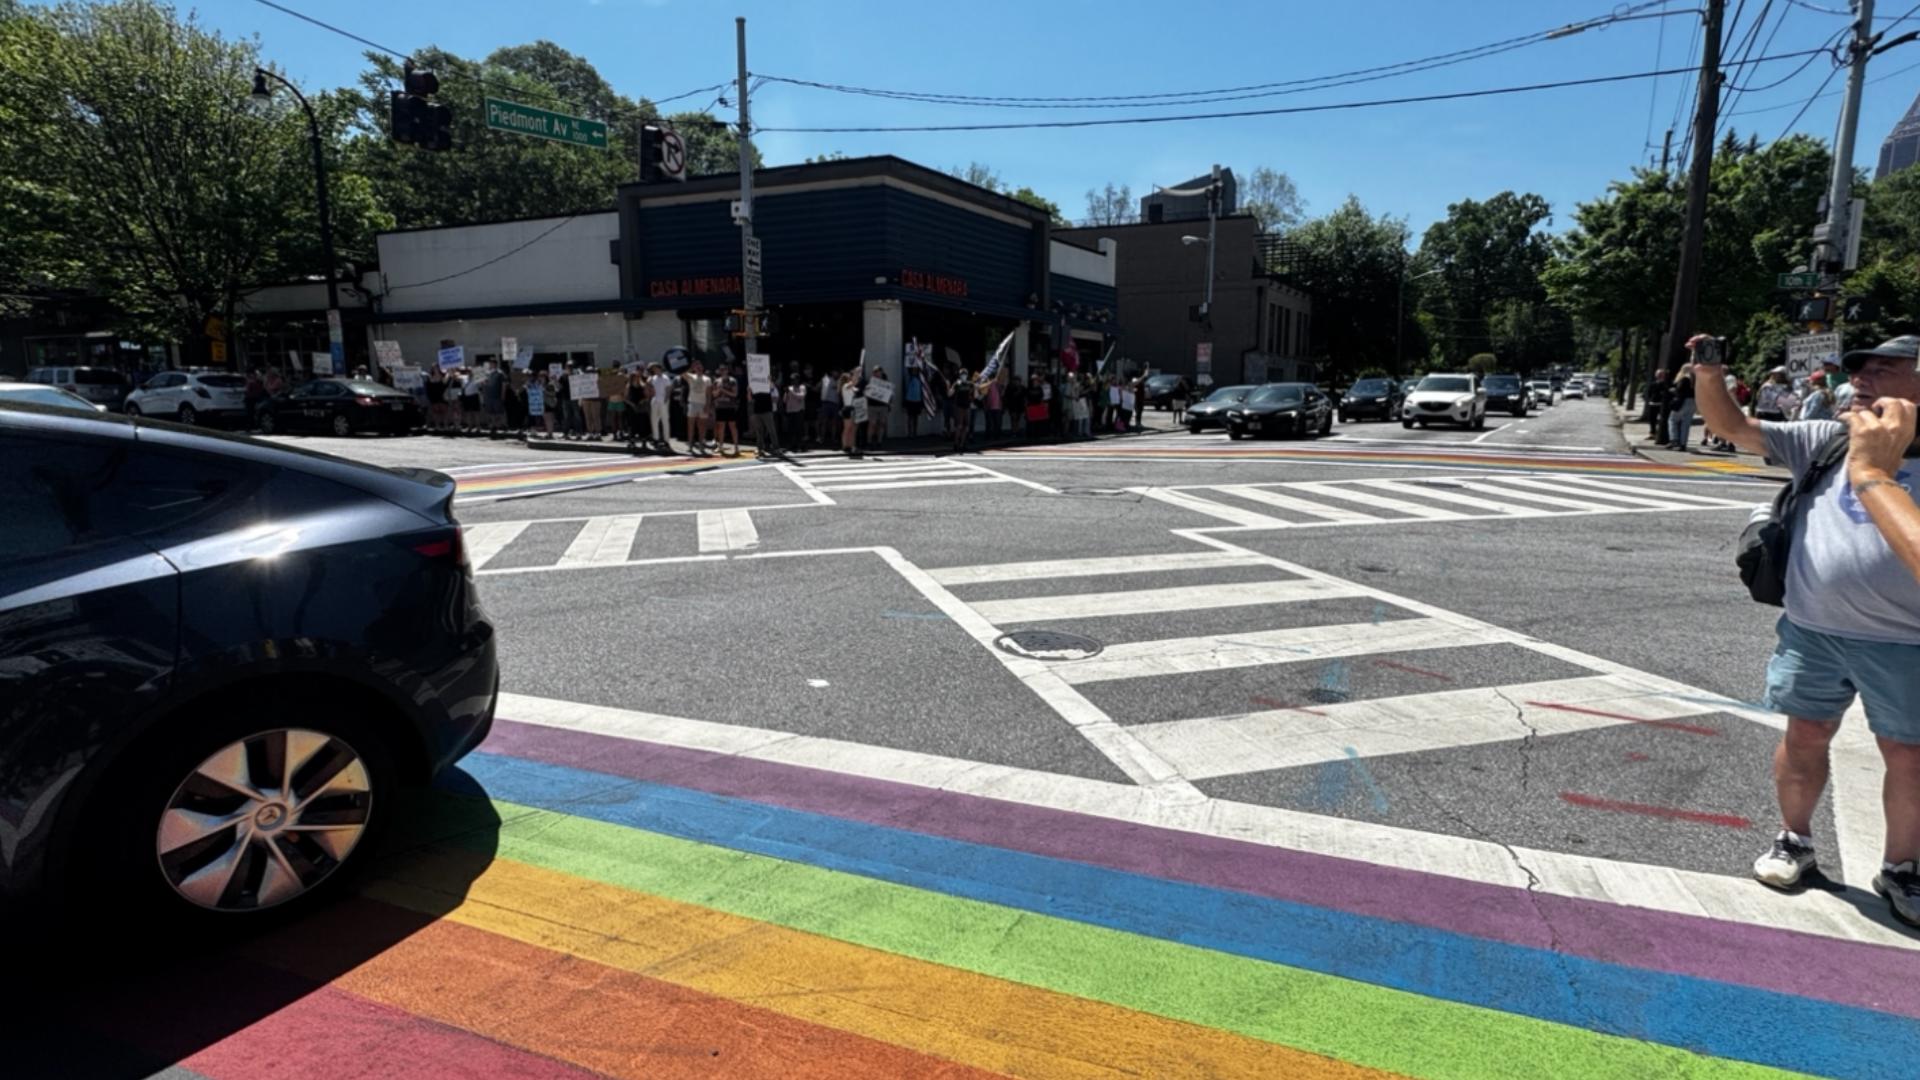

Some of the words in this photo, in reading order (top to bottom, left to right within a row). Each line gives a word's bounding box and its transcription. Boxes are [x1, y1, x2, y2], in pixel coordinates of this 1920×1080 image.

[491, 104, 548, 133] Piedmont
[553, 117, 568, 137] Av
[651, 281, 678, 298] CASA
[681, 277, 741, 296] ALMENARA
[1790, 336, 1837, 346] DIAGONAL
[1790, 343, 1837, 354] CROSSING
[1790, 359, 1808, 372] OK
